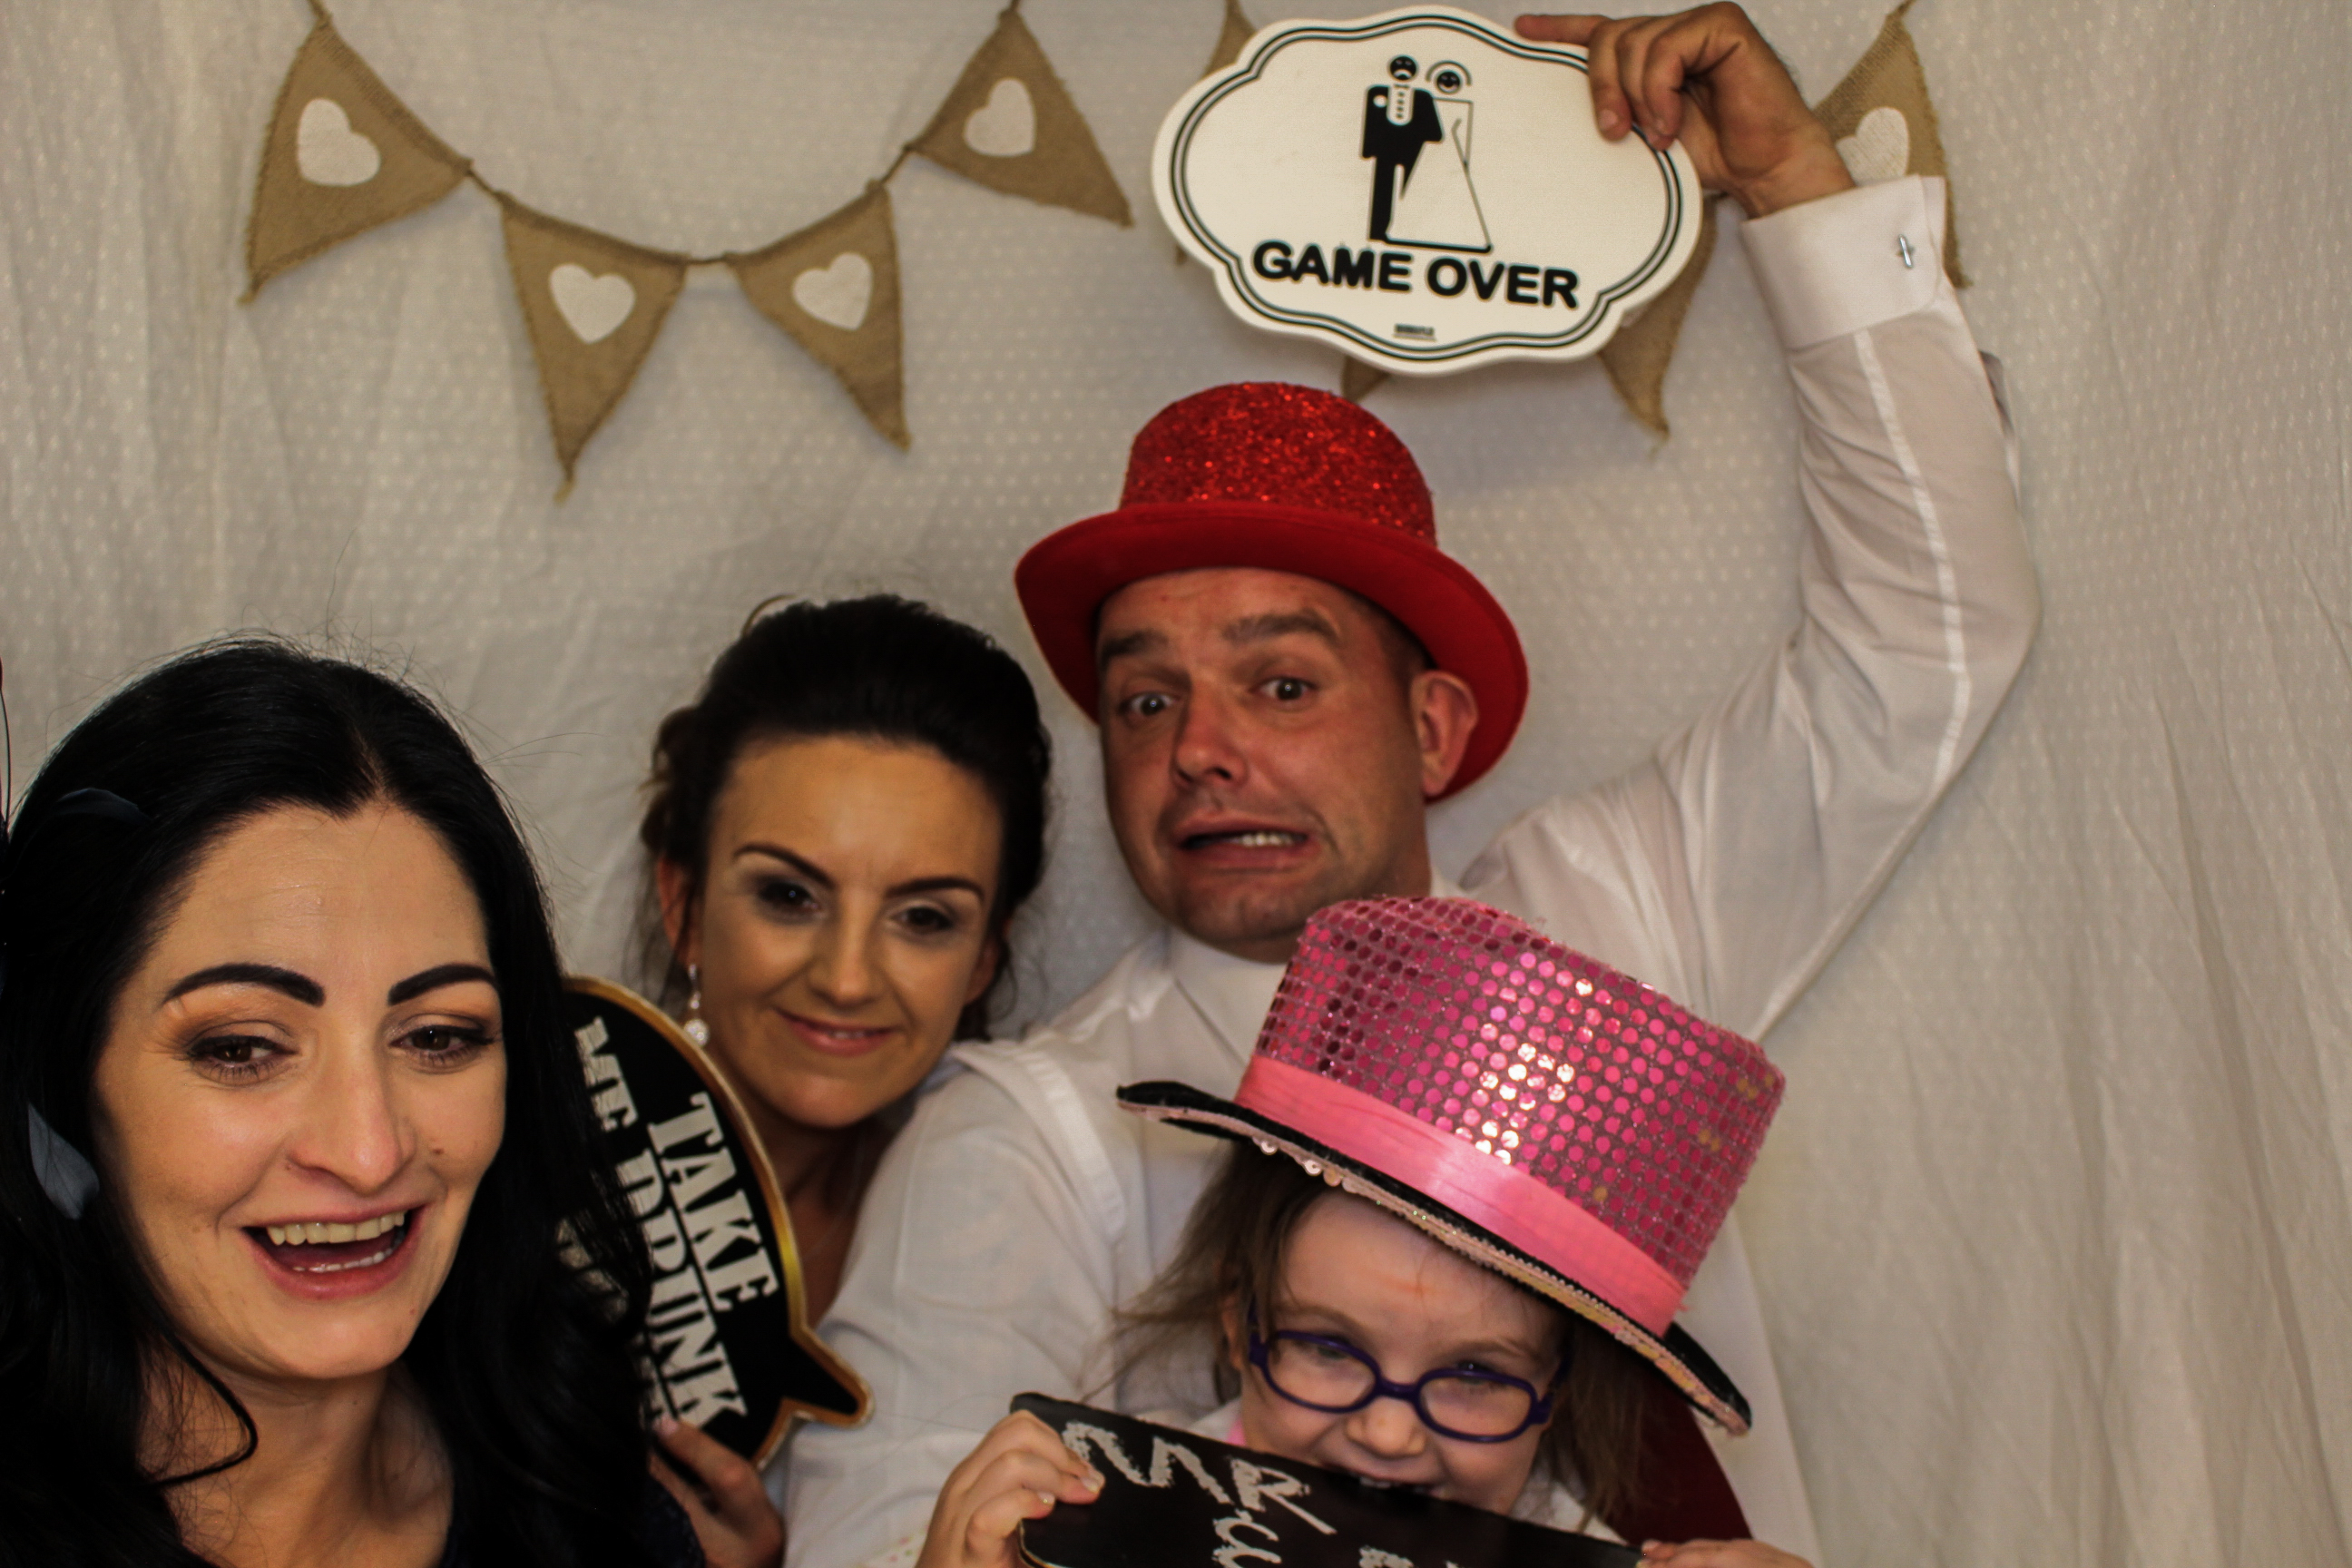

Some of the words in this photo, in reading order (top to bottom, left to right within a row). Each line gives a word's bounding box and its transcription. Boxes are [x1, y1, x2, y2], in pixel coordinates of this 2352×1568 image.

[1252, 240, 1413, 292] GAME
[1427, 258, 1579, 309] OVER
[647, 1092, 779, 1312] TAKE
